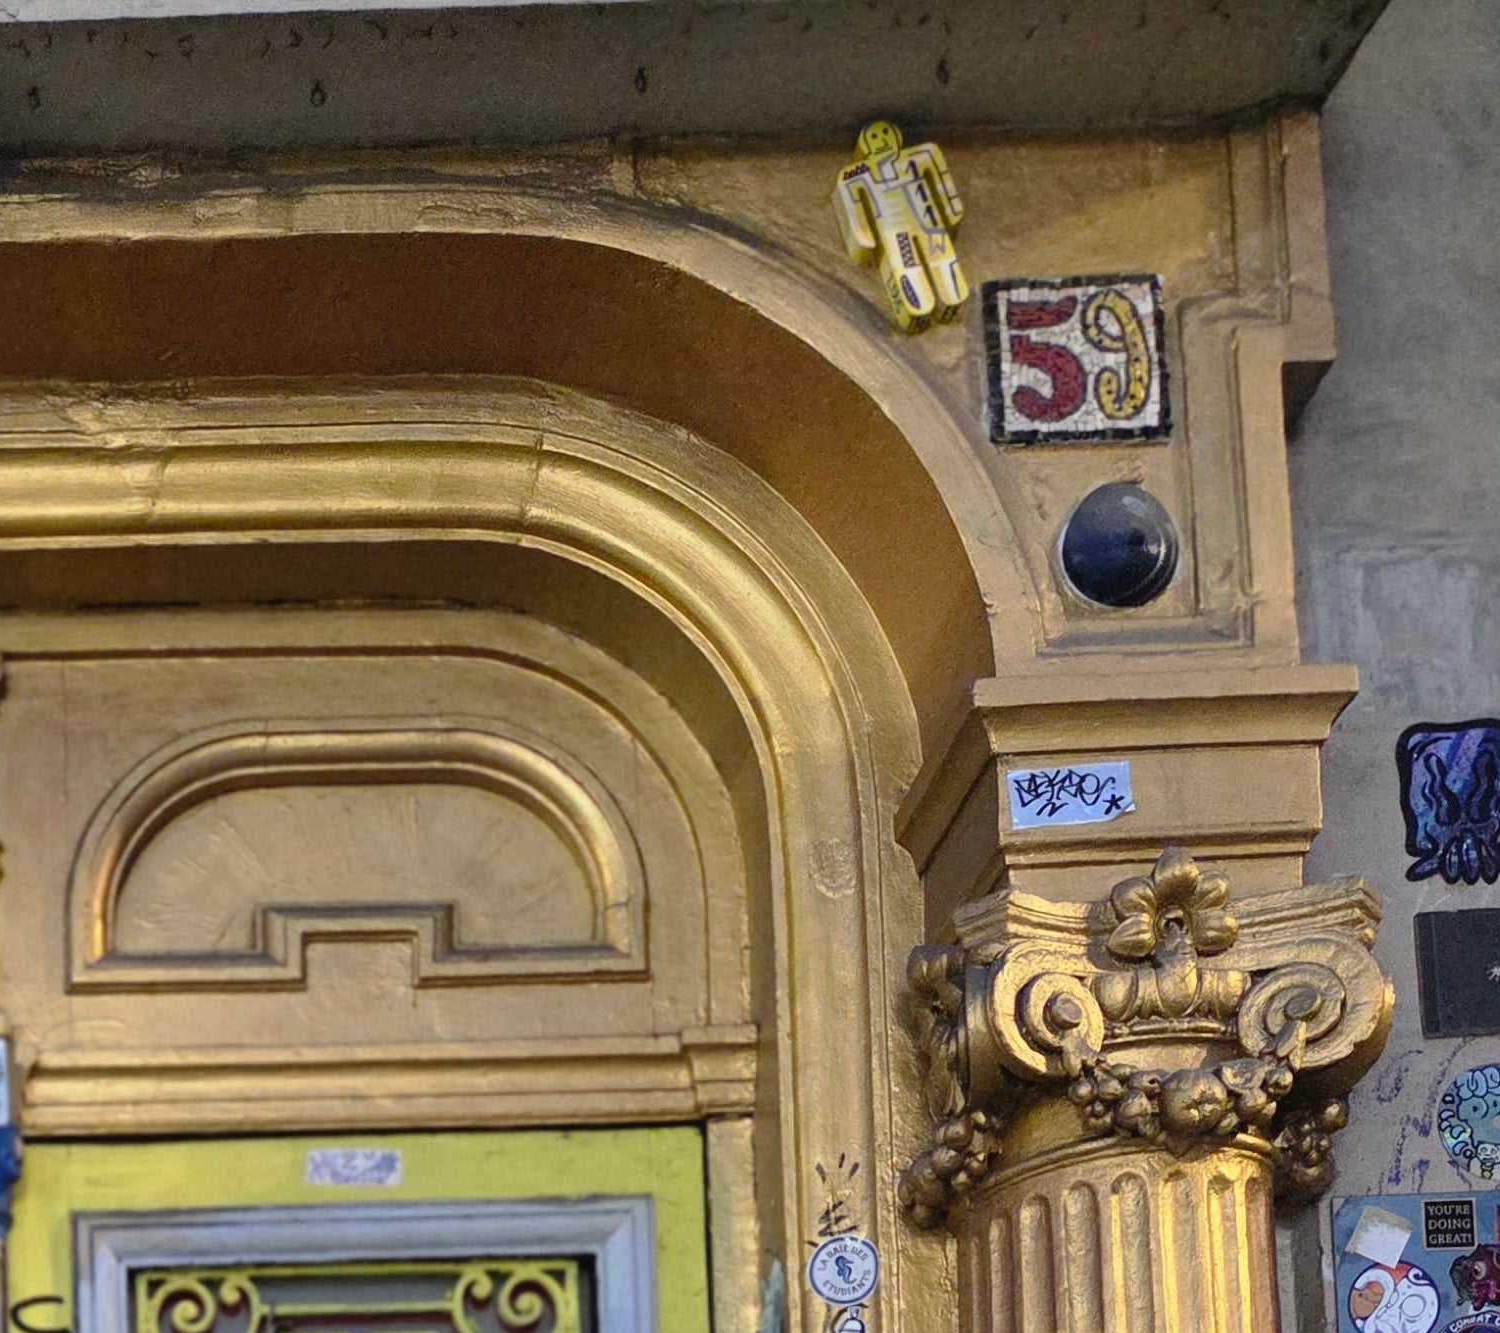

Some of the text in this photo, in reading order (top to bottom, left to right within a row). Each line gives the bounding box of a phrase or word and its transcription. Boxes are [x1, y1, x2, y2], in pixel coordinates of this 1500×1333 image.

[1007, 290, 1150, 421] 59
[1427, 1205, 1470, 1216] YOU'RE
[1428, 1219, 1471, 1231] DOING
[1429, 1234, 1472, 1246] GREAT!
